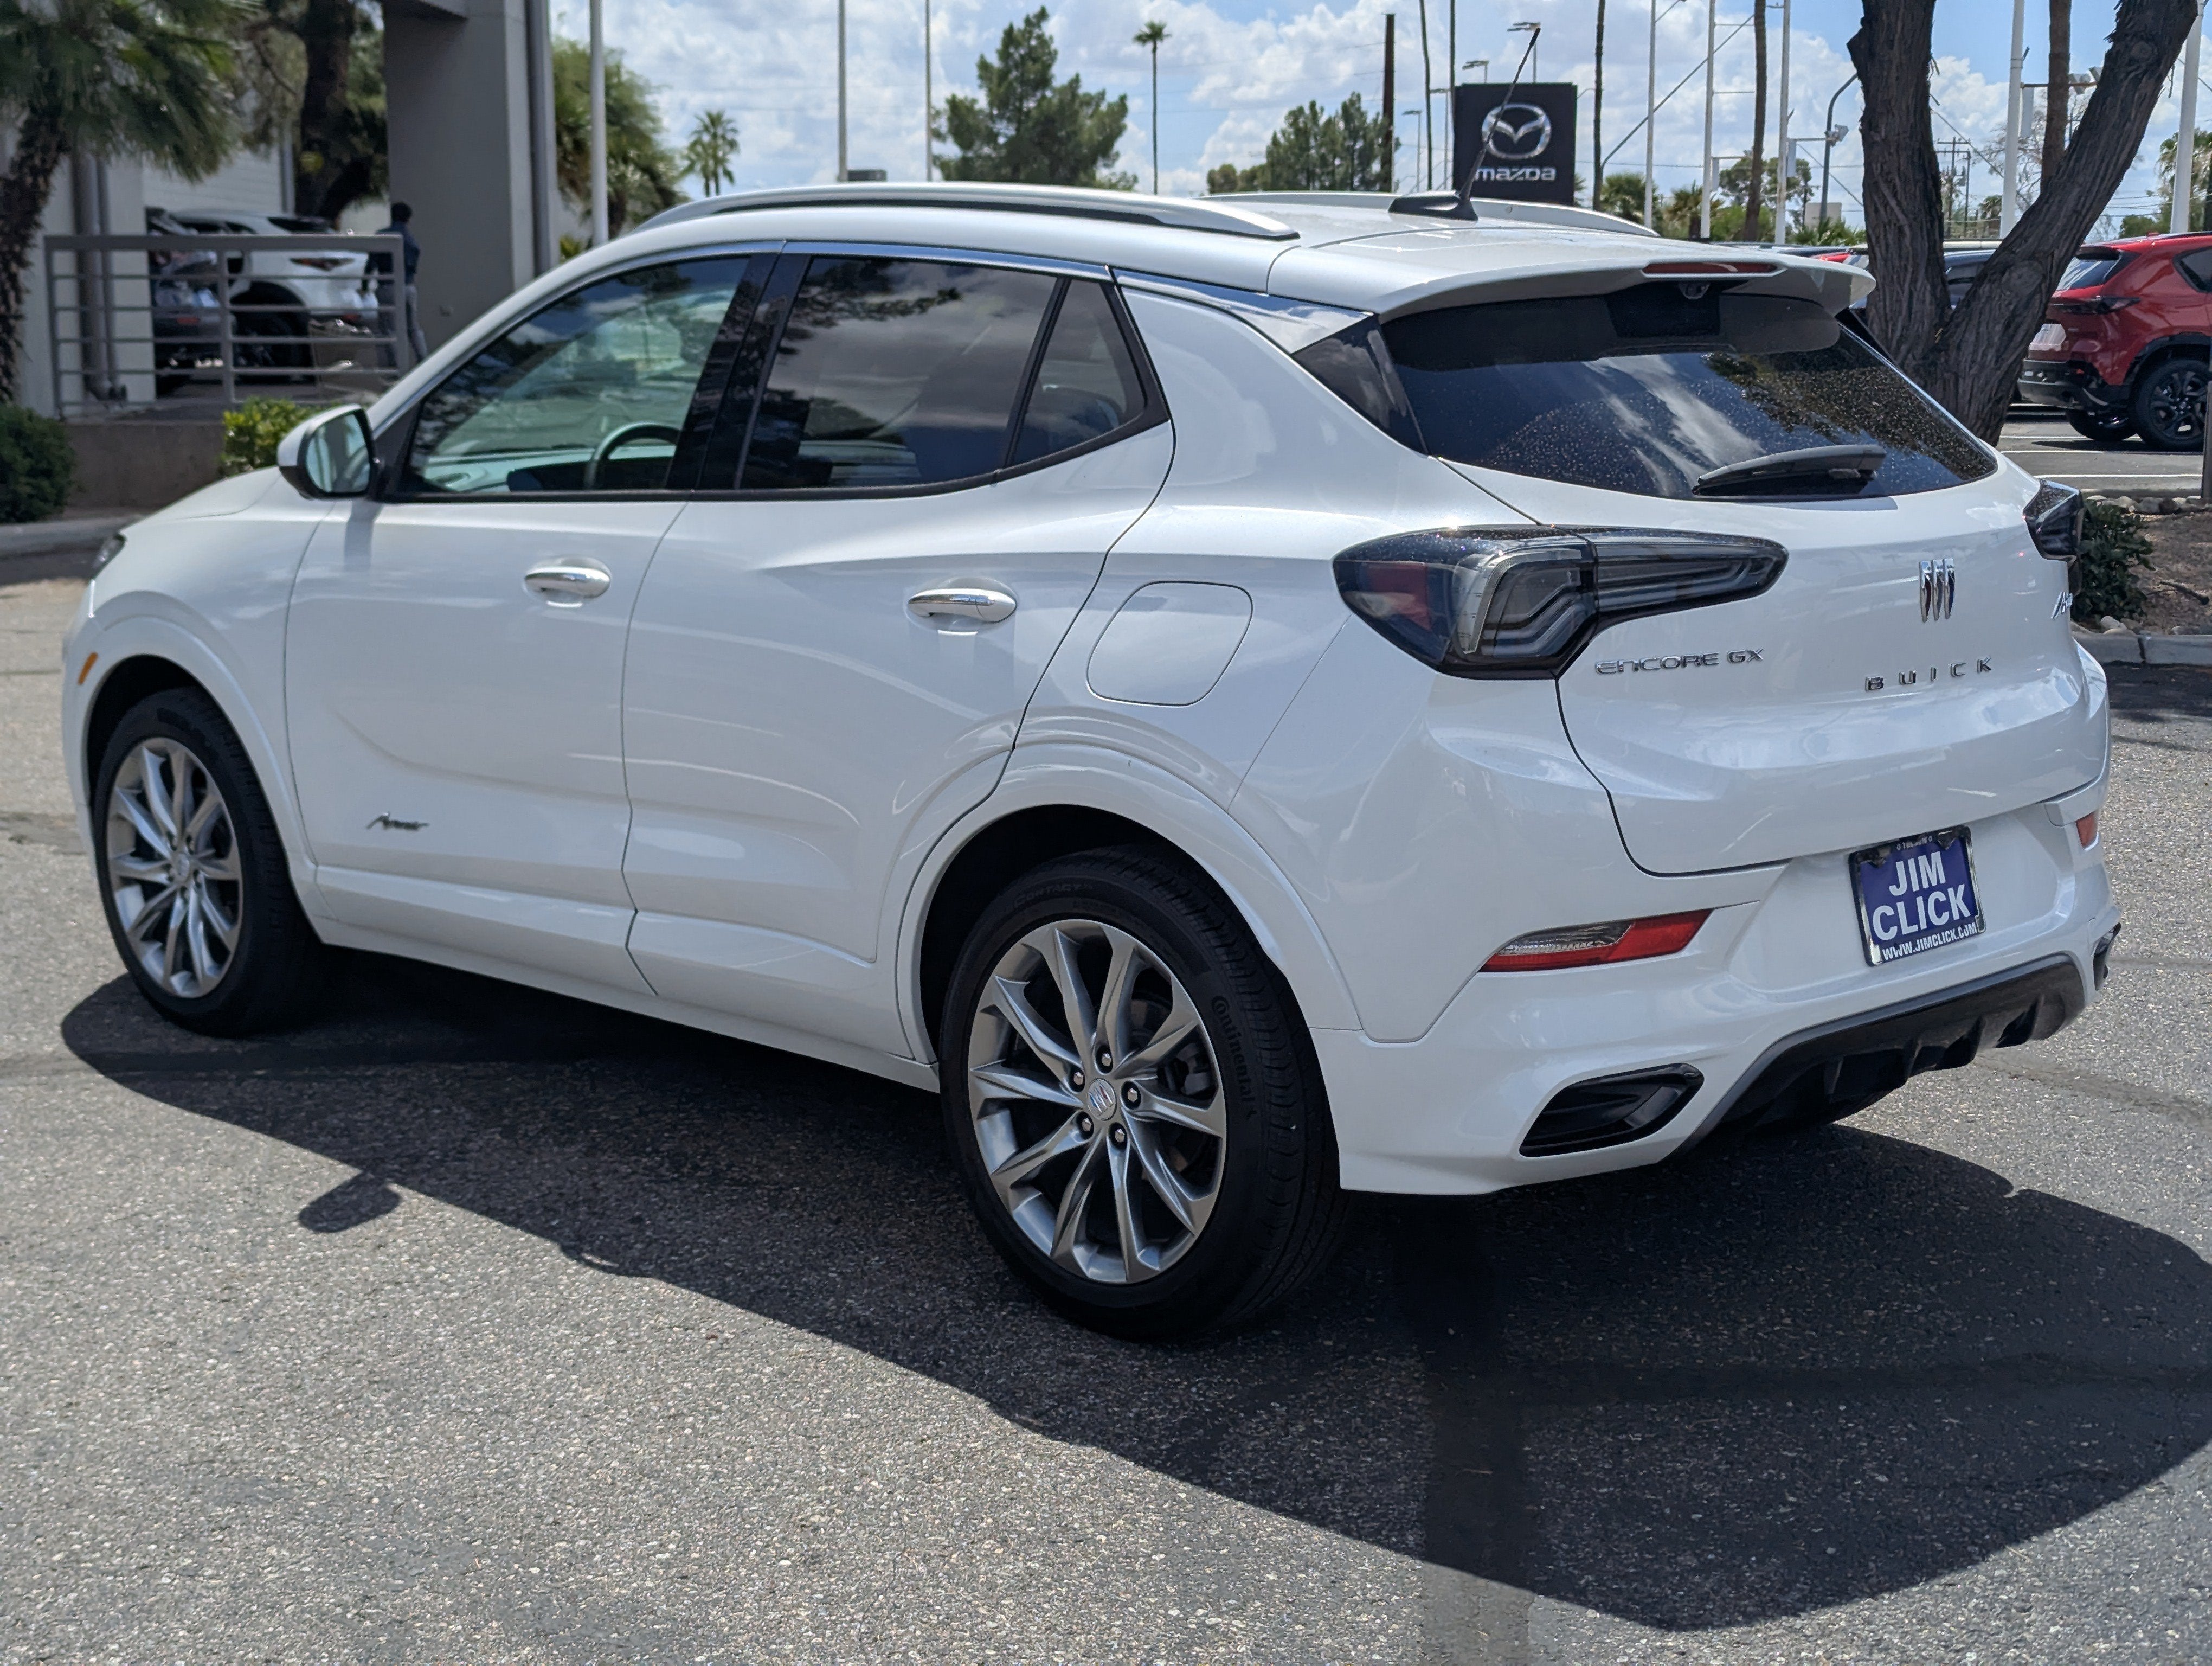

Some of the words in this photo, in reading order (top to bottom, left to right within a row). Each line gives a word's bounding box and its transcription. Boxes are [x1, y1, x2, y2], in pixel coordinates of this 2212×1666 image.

[1595, 652, 1720, 675] ENCORE
[1726, 648, 1764, 663] GX
[1865, 657, 1992, 691] BUICK
[1888, 851, 1946, 896] JIM
[1872, 883, 1971, 941] CLICK
